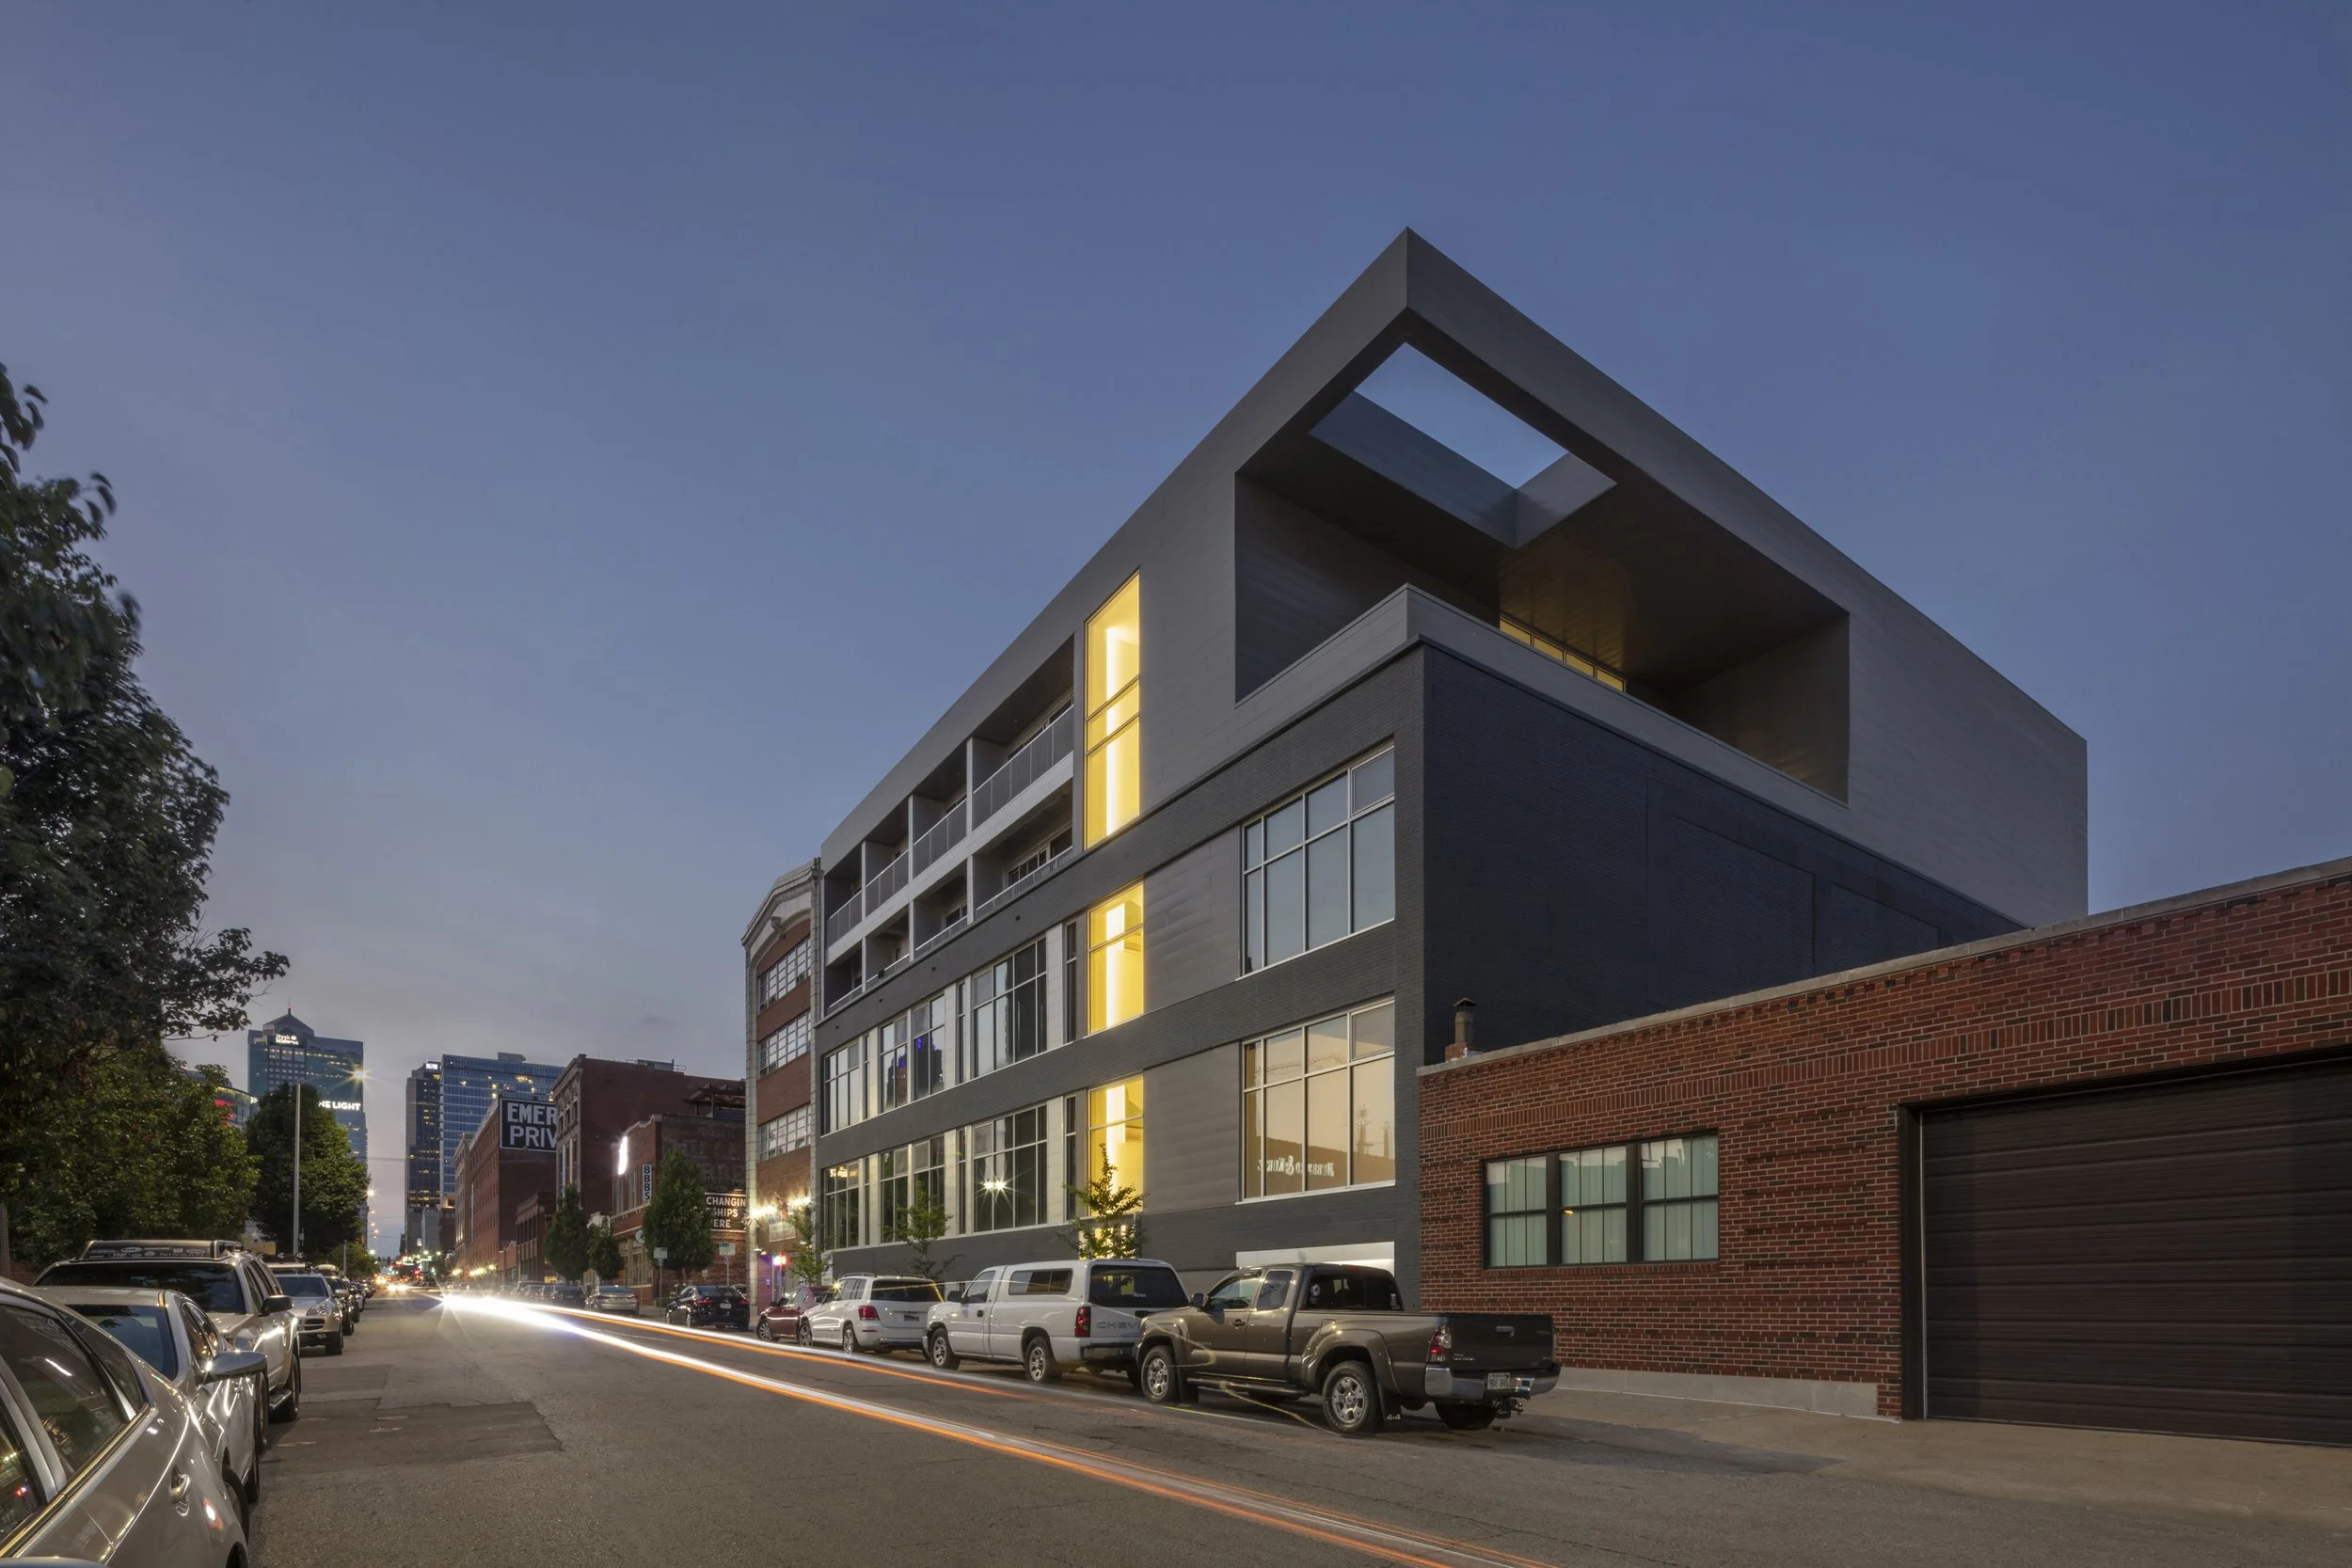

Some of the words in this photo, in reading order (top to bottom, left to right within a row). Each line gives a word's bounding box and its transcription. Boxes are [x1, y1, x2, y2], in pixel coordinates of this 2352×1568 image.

[332, 1101, 361, 1110] LIGHT
[706, 1196, 746, 1207] CHANGIN
[711, 1219, 731, 1228] ERE
